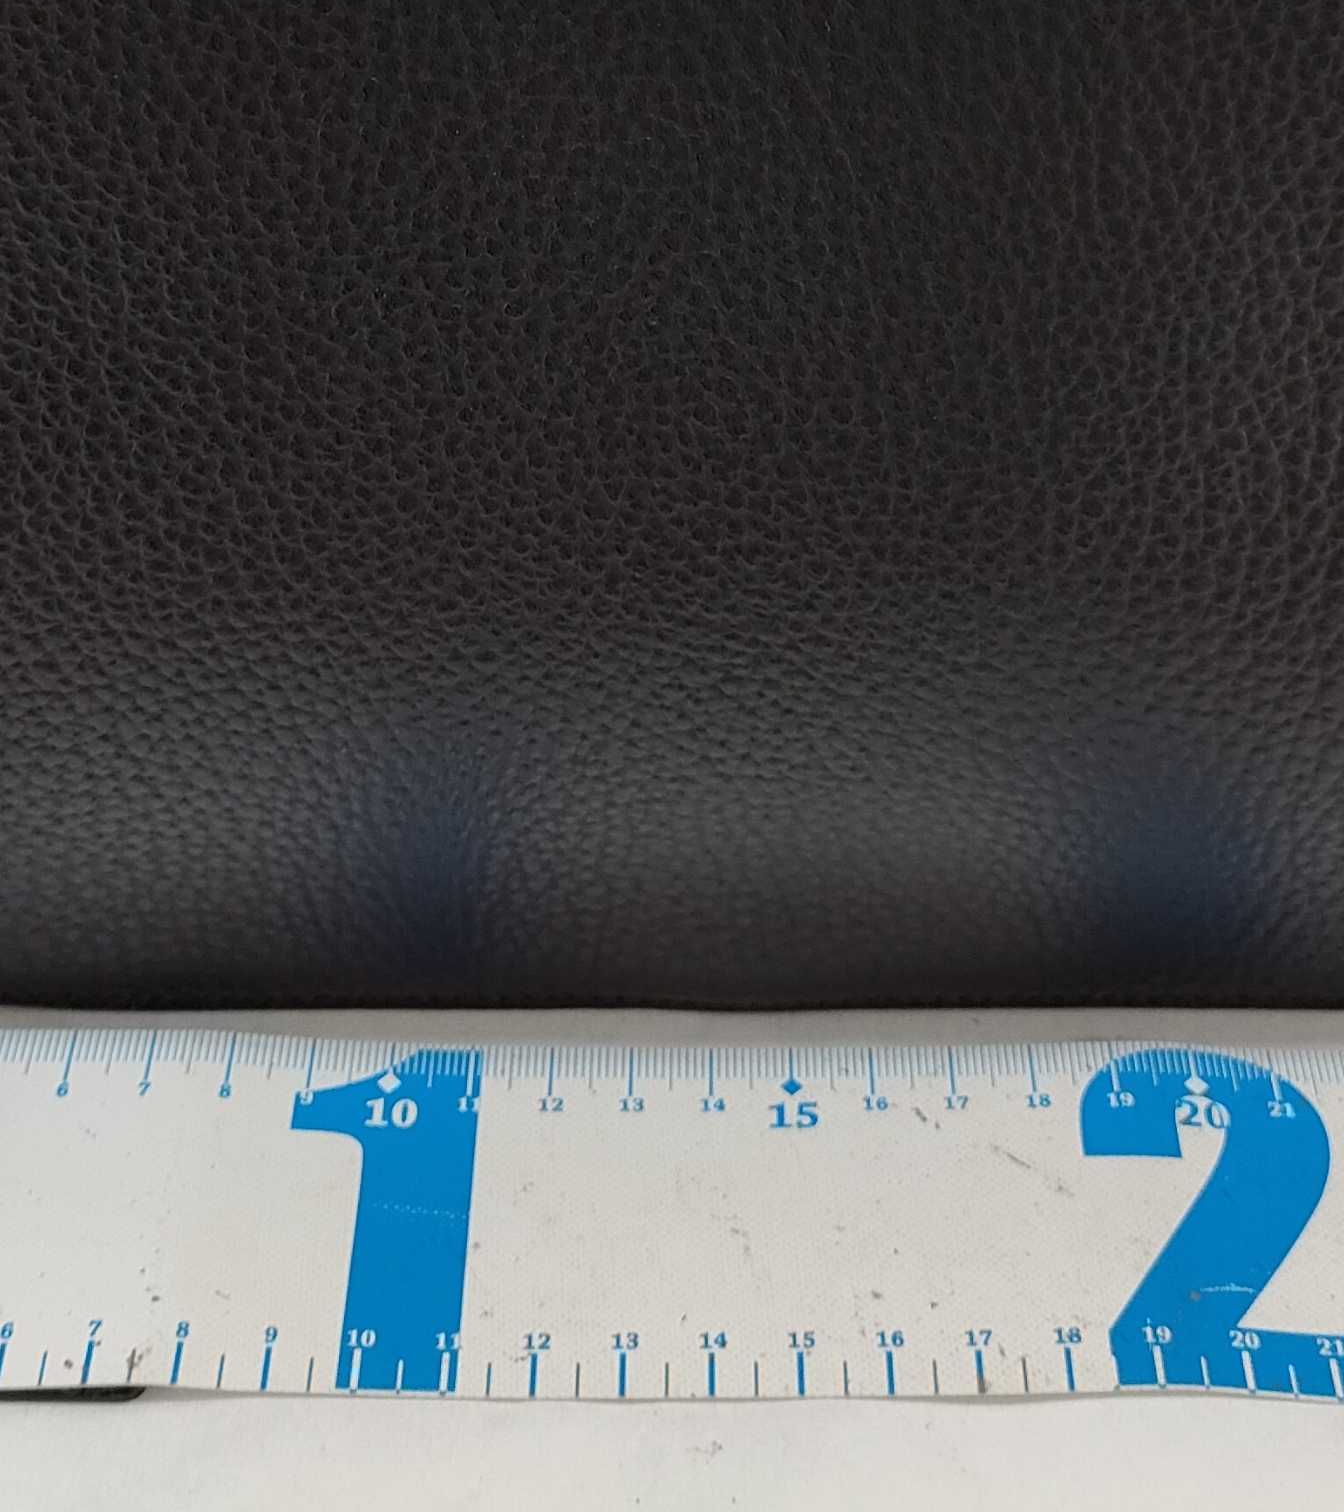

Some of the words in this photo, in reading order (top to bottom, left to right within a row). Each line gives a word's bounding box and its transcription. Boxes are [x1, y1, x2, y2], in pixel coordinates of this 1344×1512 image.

[57, 1081, 70, 1097] 6
[138, 1081, 151, 1095] 7
[364, 1097, 418, 1128] 10
[539, 1097, 564, 1111] 12
[619, 1097, 644, 1112] 13
[699, 1097, 725, 1112] 14
[769, 1101, 819, 1129] 15
[863, 1096, 888, 1110] 16
[944, 1095, 968, 1110] 17
[1026, 1093, 1051, 1108] 18
[1107, 1092, 1135, 1108] 19
[1177, 1098, 1229, 1129] 20
[1267, 1101, 1295, 1118] 21
[291, 1049, 483, 1391] 1
[0, 1321, 14, 1339] 6
[89, 1319, 102, 1337] 7
[176, 1320, 190, 1338] 8
[264, 1326, 278, 1344] 9
[346, 1329, 376, 1348] 10
[435, 1332, 461, 1350] 11
[523, 1333, 551, 1350] 12
[611, 1332, 639, 1350] 13
[700, 1332, 727, 1349] 14
[788, 1331, 816, 1348] 15
[876, 1331, 904, 1348] 16
[965, 1330, 992, 1347] 17
[1054, 1327, 1082, 1344] 18
[1142, 1325, 1172, 1344] 19
[1229, 1330, 1261, 1349] 20
